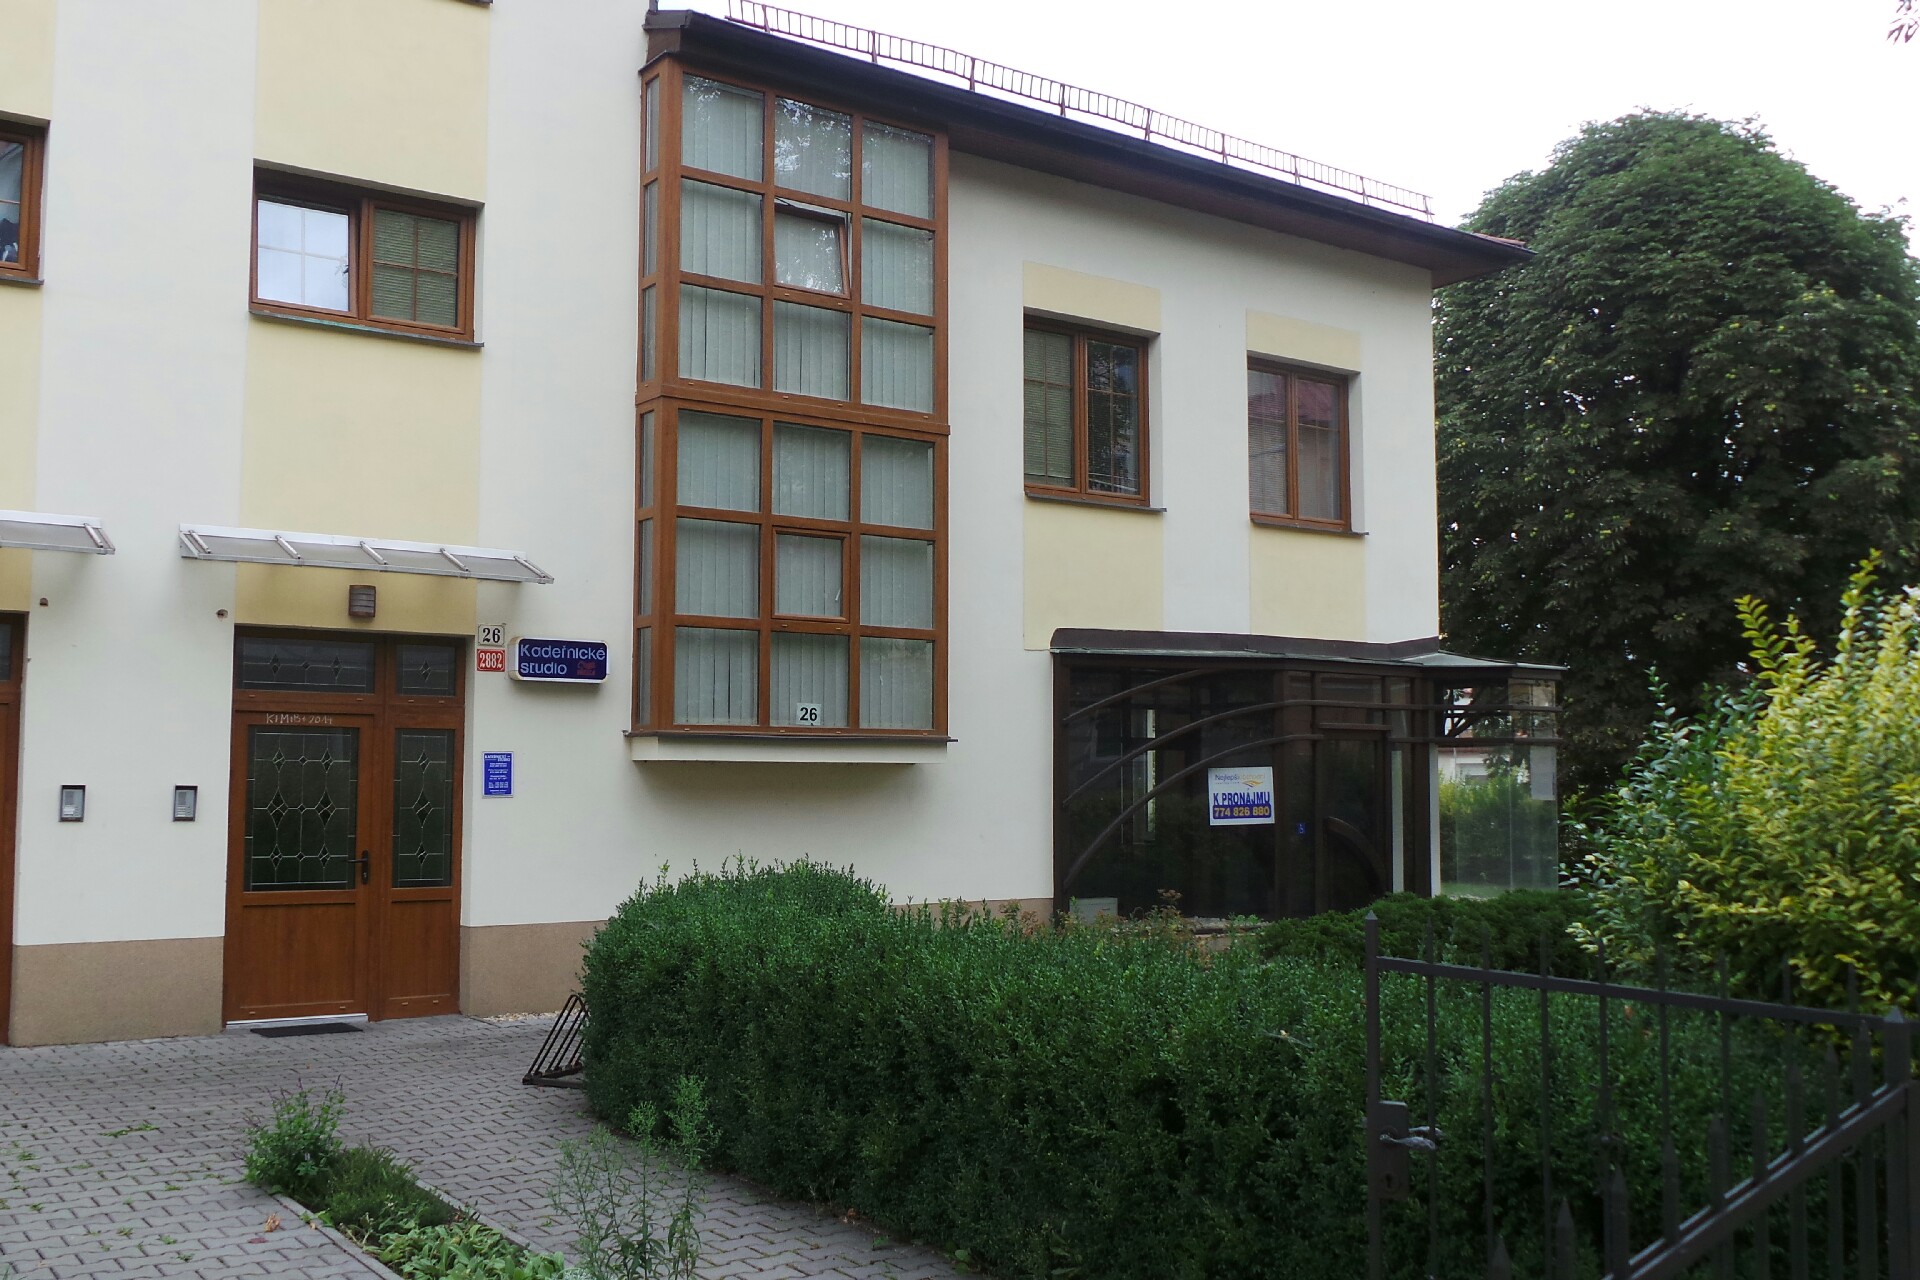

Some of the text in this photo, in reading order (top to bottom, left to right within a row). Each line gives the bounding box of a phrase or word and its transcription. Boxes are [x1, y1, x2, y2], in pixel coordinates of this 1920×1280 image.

[482, 627, 501, 643] 26
[480, 652, 502, 668] 2882
[520, 644, 606, 660] Kadeřnické
[520, 661, 567, 675] studio
[800, 707, 817, 721] 26
[1213, 788, 1270, 805] K PRONÁJMU
[1214, 807, 1230, 817] 774
[1233, 806, 1250, 817] 826
